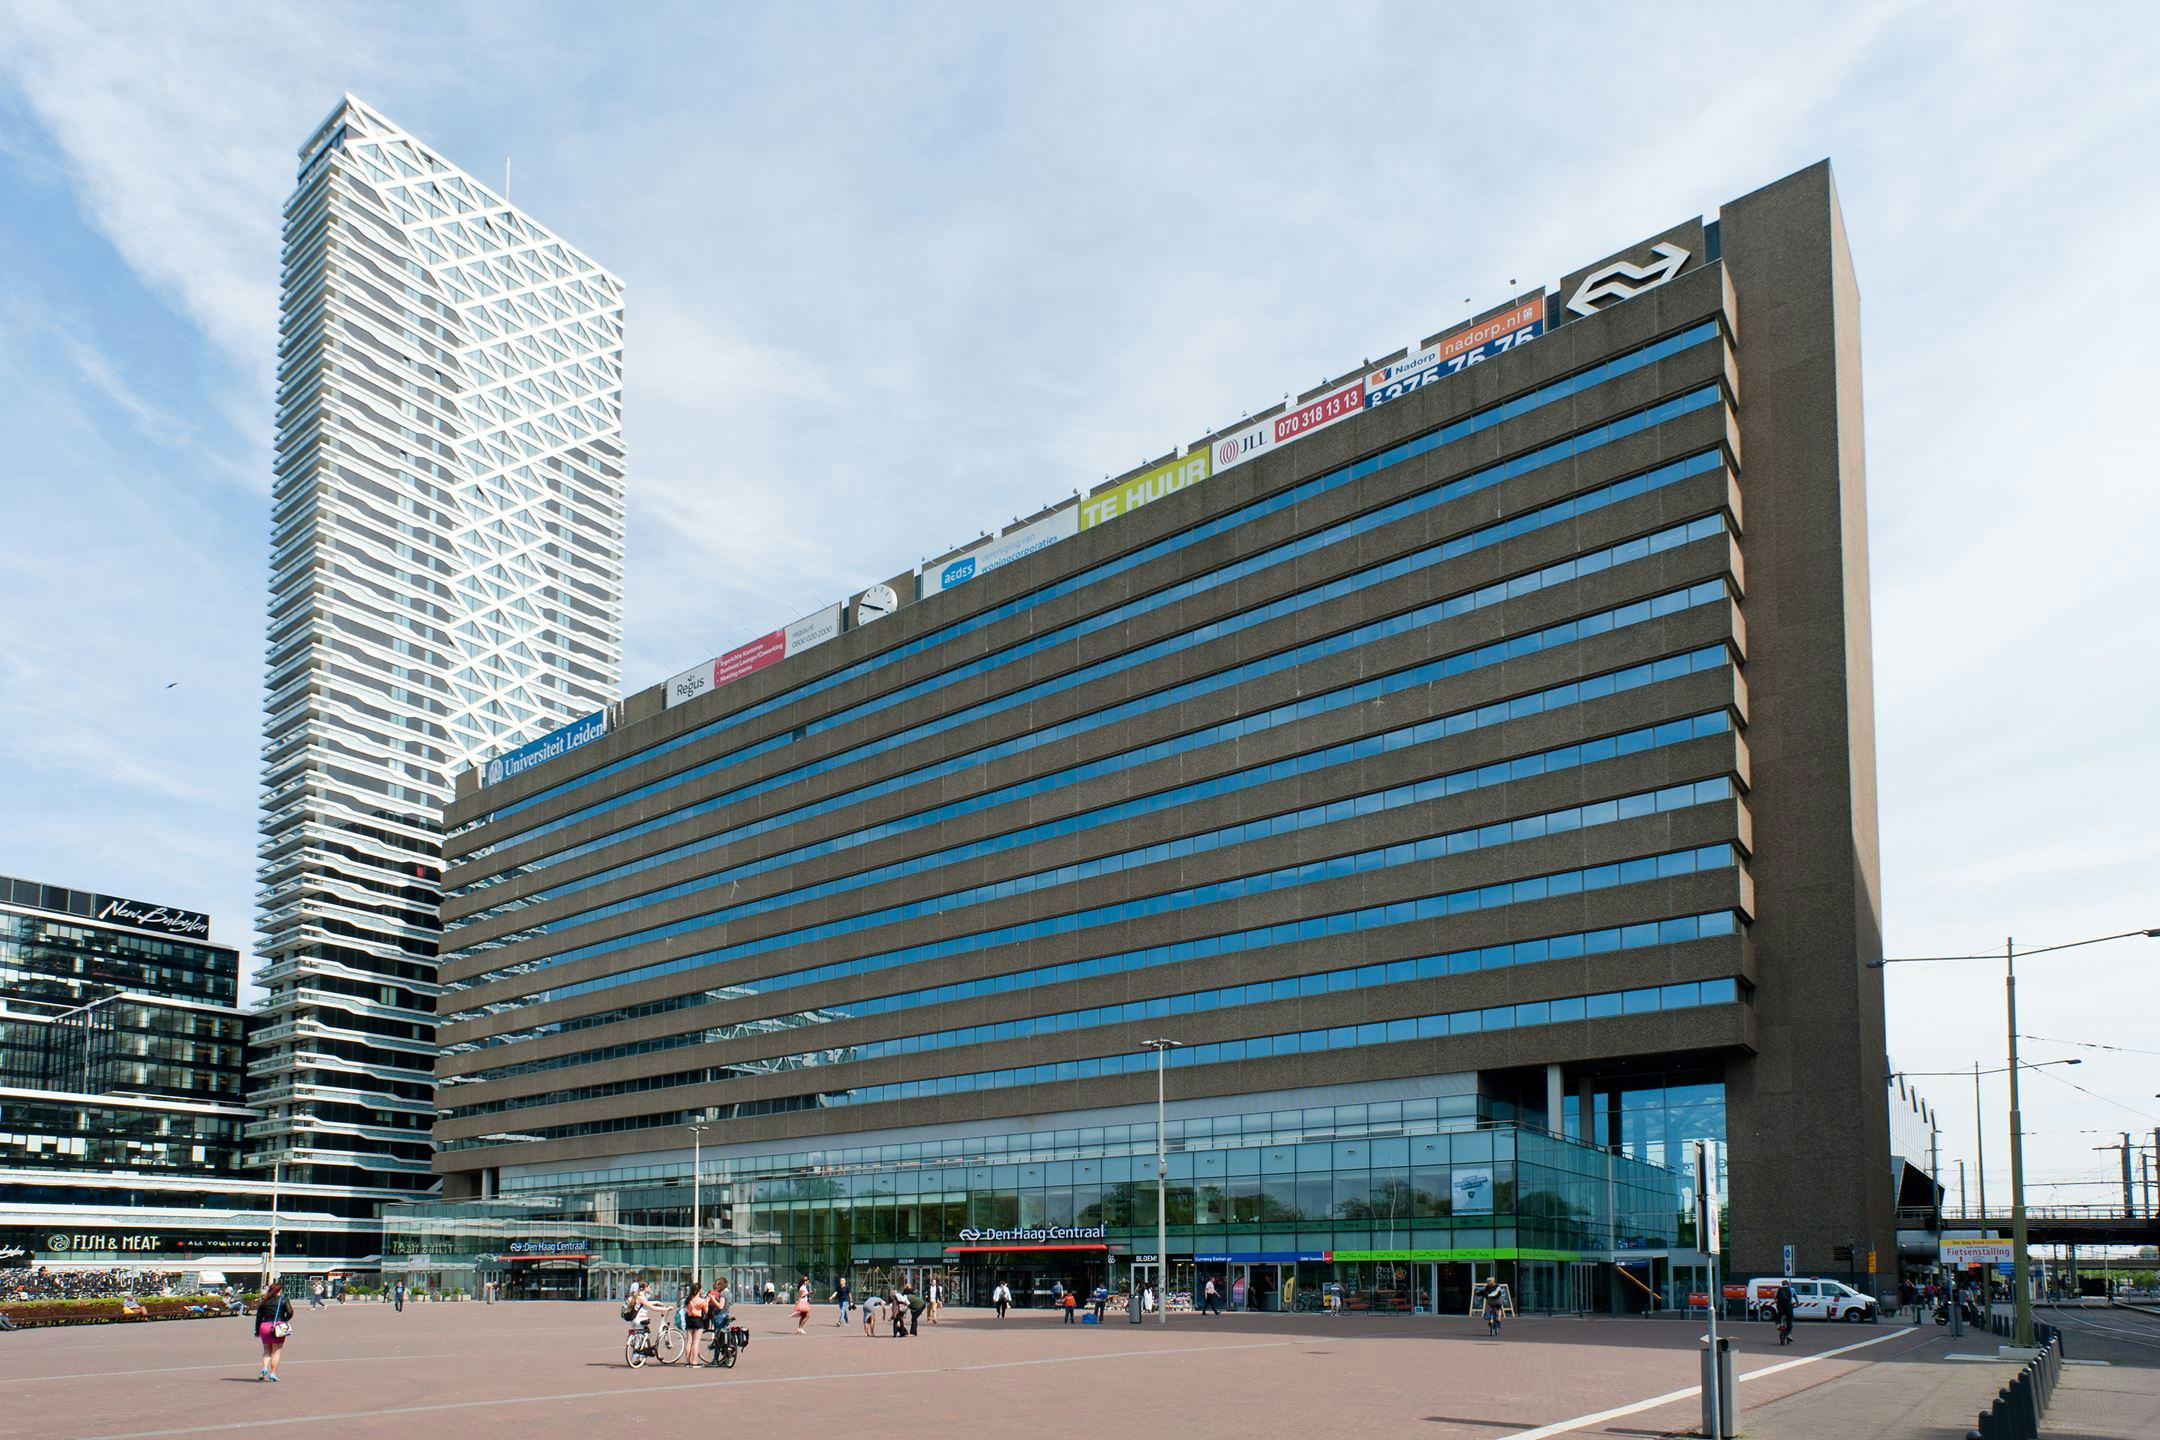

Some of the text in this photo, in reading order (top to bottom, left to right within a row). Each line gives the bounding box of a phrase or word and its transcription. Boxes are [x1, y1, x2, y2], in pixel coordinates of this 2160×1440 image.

[1445, 312, 1520, 355] nadorp.nl
[1395, 353, 1436, 374] Nadorp
[1278, 416, 1299, 437] 070
[1301, 406, 1323, 427] 318
[1326, 399, 1340, 416] 13
[1343, 390, 1358, 409] 13
[1241, 430, 1268, 453] JLL
[1083, 458, 1207, 528] TE HUUR
[676, 675, 705, 697] Regus
[505, 723, 604, 776] Universiteit Leiden
[99, 900, 208, 933] New Babylon
[73, 1235, 158, 1250] FISH & MEAT
[986, 1224, 1105, 1242] Den Haag Centraal
[523, 1241, 586, 1253] Den Haag Centraal
[1946, 1247, 2010, 1256] Fietsenstalling
